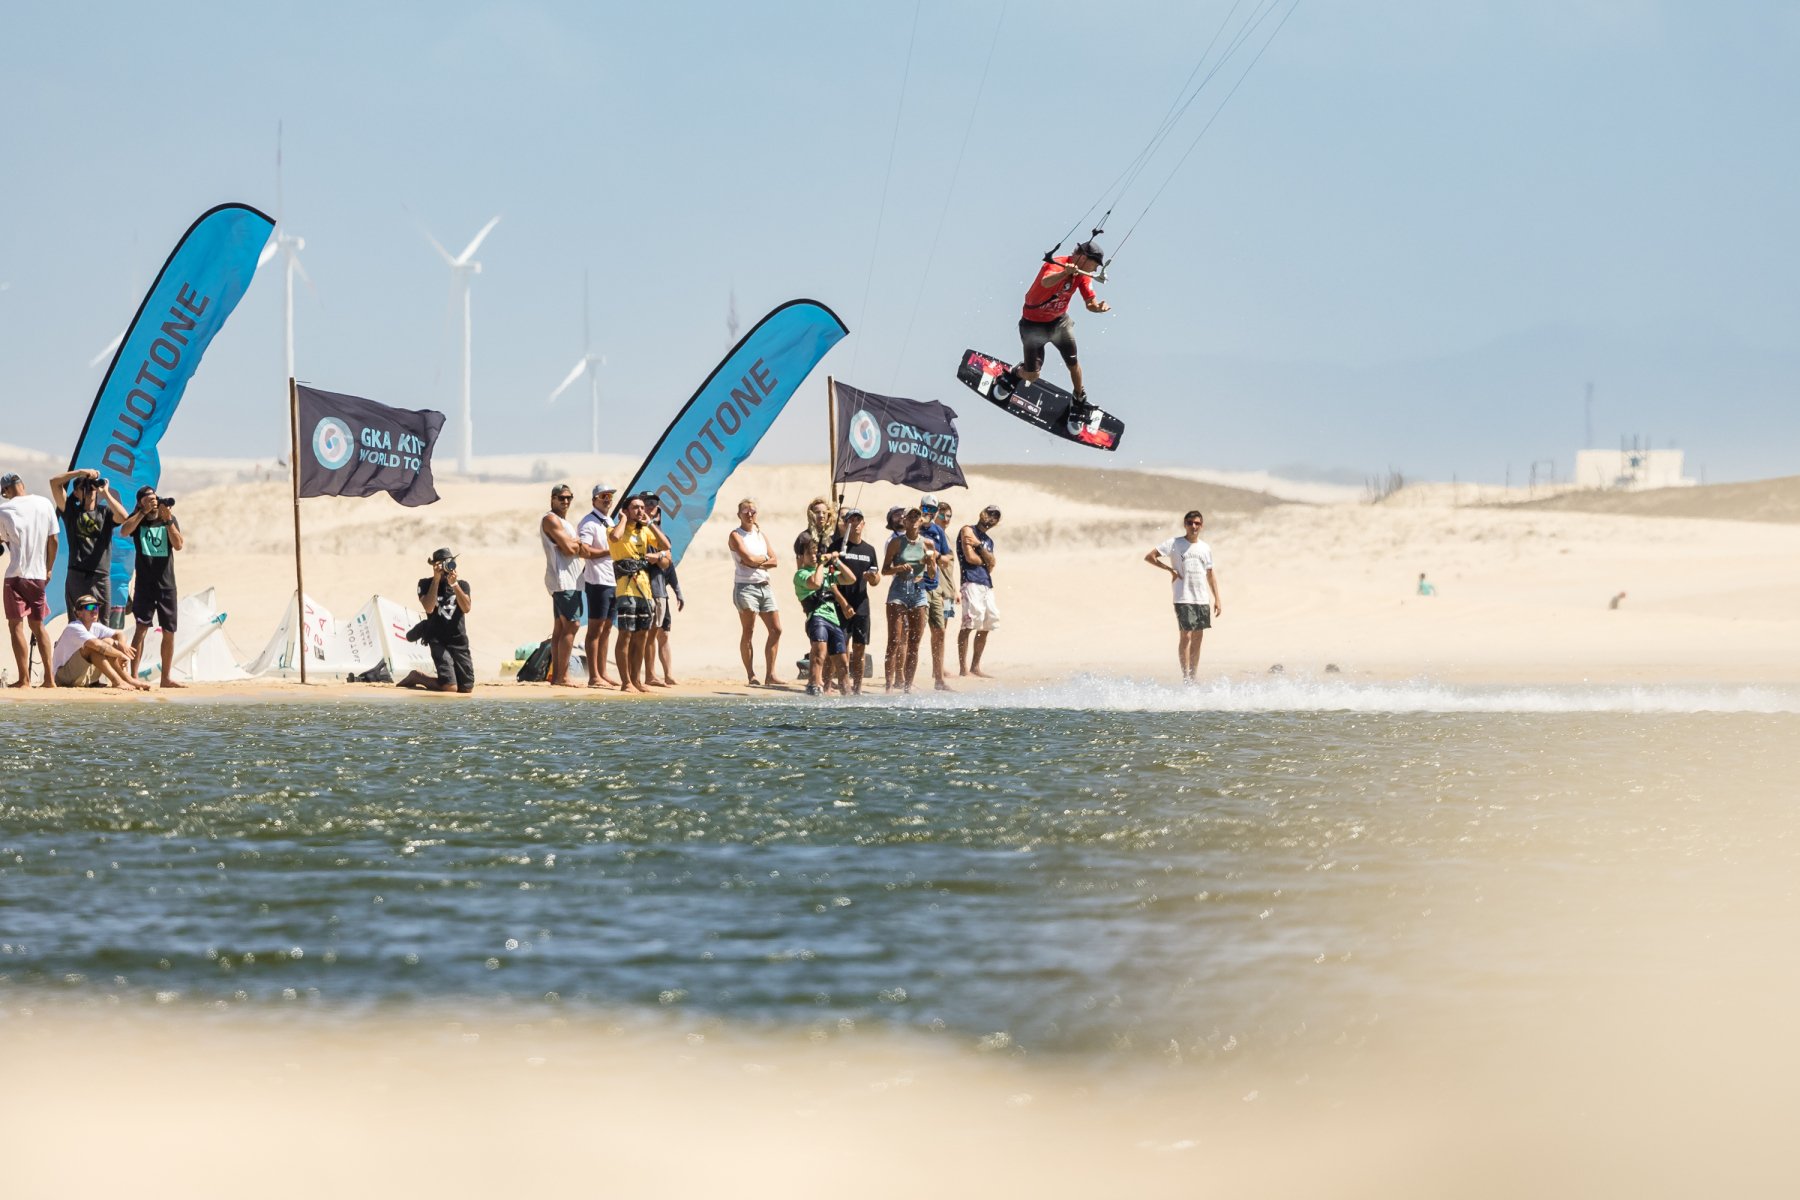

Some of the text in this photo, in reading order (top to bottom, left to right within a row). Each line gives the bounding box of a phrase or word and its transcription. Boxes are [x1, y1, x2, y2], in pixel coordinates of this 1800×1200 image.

[101, 282, 210, 477] DUOTONE
[361, 427, 426, 456] GKA KIT
[655, 357, 779, 521] DUOTONE
[888, 440, 928, 458] WORLD
[359, 448, 422, 475] WORLD TO
